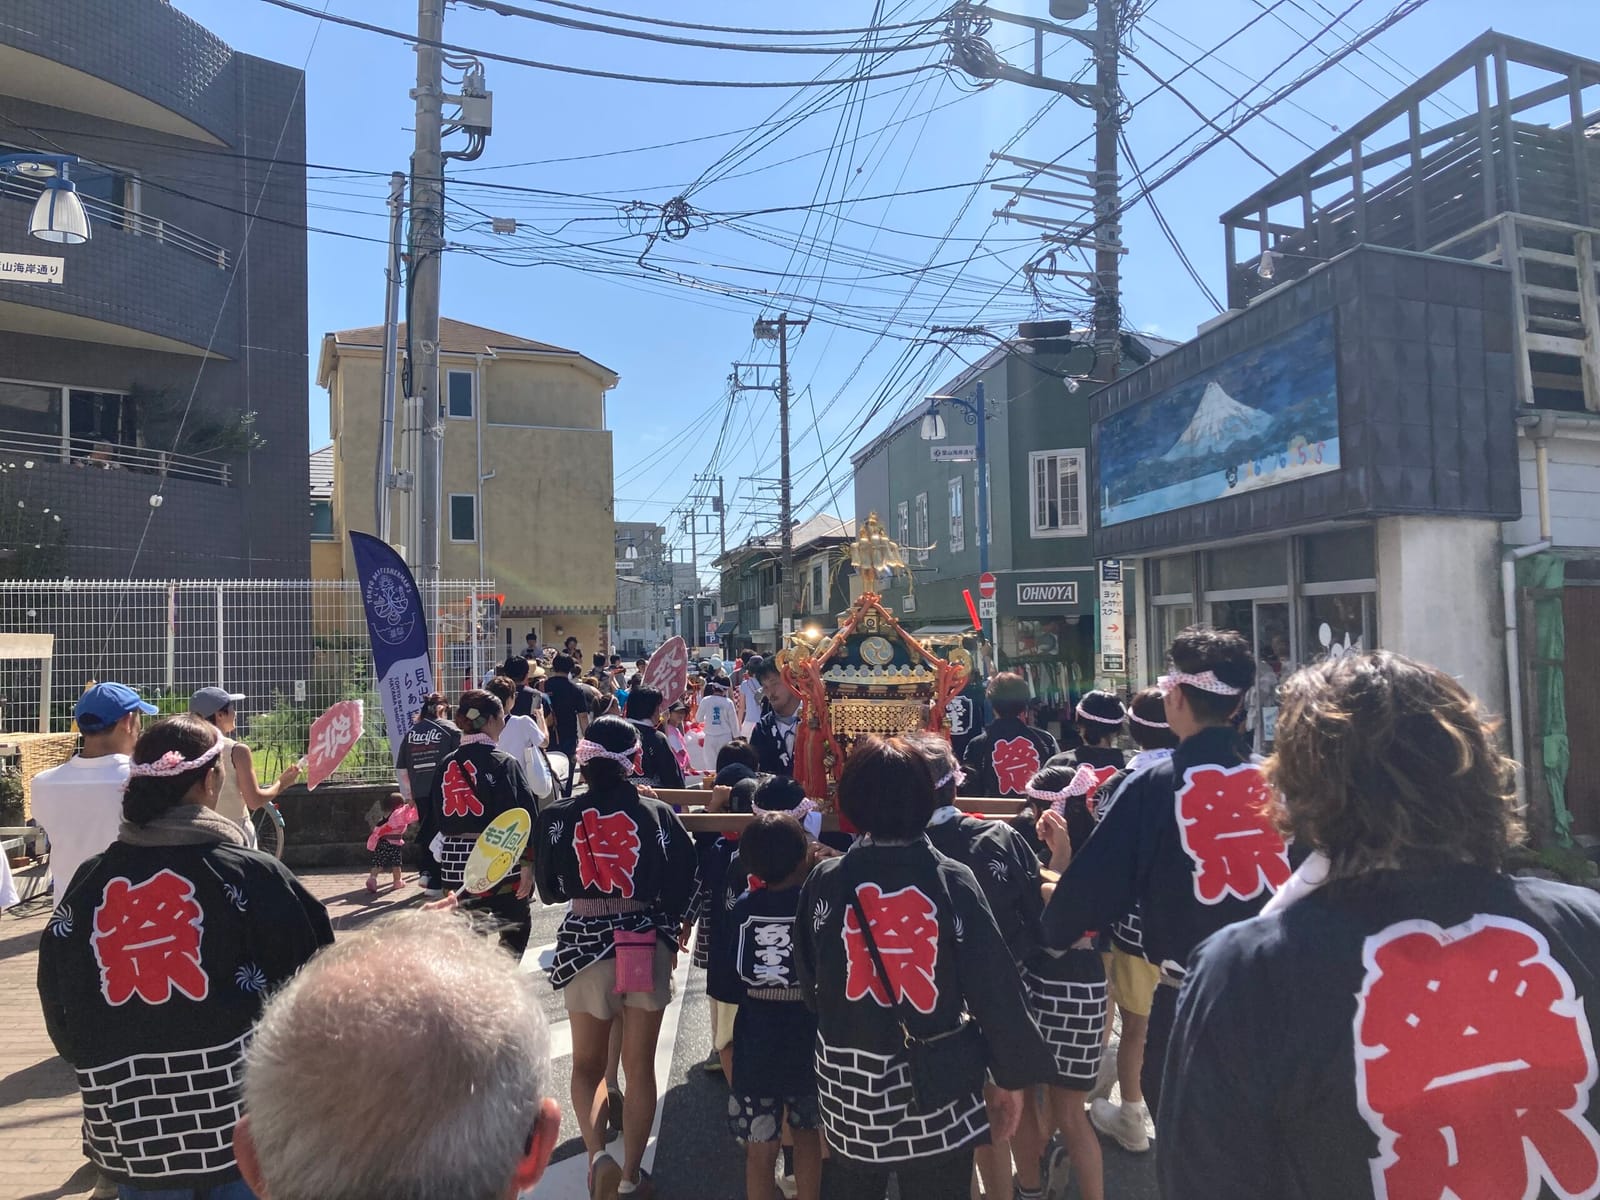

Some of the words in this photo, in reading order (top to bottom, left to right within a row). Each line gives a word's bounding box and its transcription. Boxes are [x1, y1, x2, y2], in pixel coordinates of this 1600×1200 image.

[0, 261, 58, 276] 山海岸通り
[1022, 586, 1073, 600] OHNOYA
[312, 714, 352, 767] 祭
[408, 728, 442, 745] Pacific
[992, 736, 1040, 795] 祭
[441, 760, 485, 817] 祭
[572, 807, 641, 898] 祭
[1174, 763, 1295, 906] 祭
[89, 868, 209, 1007] 祭
[841, 882, 939, 1014] 祭
[1353, 913, 1600, 1200] 祭
